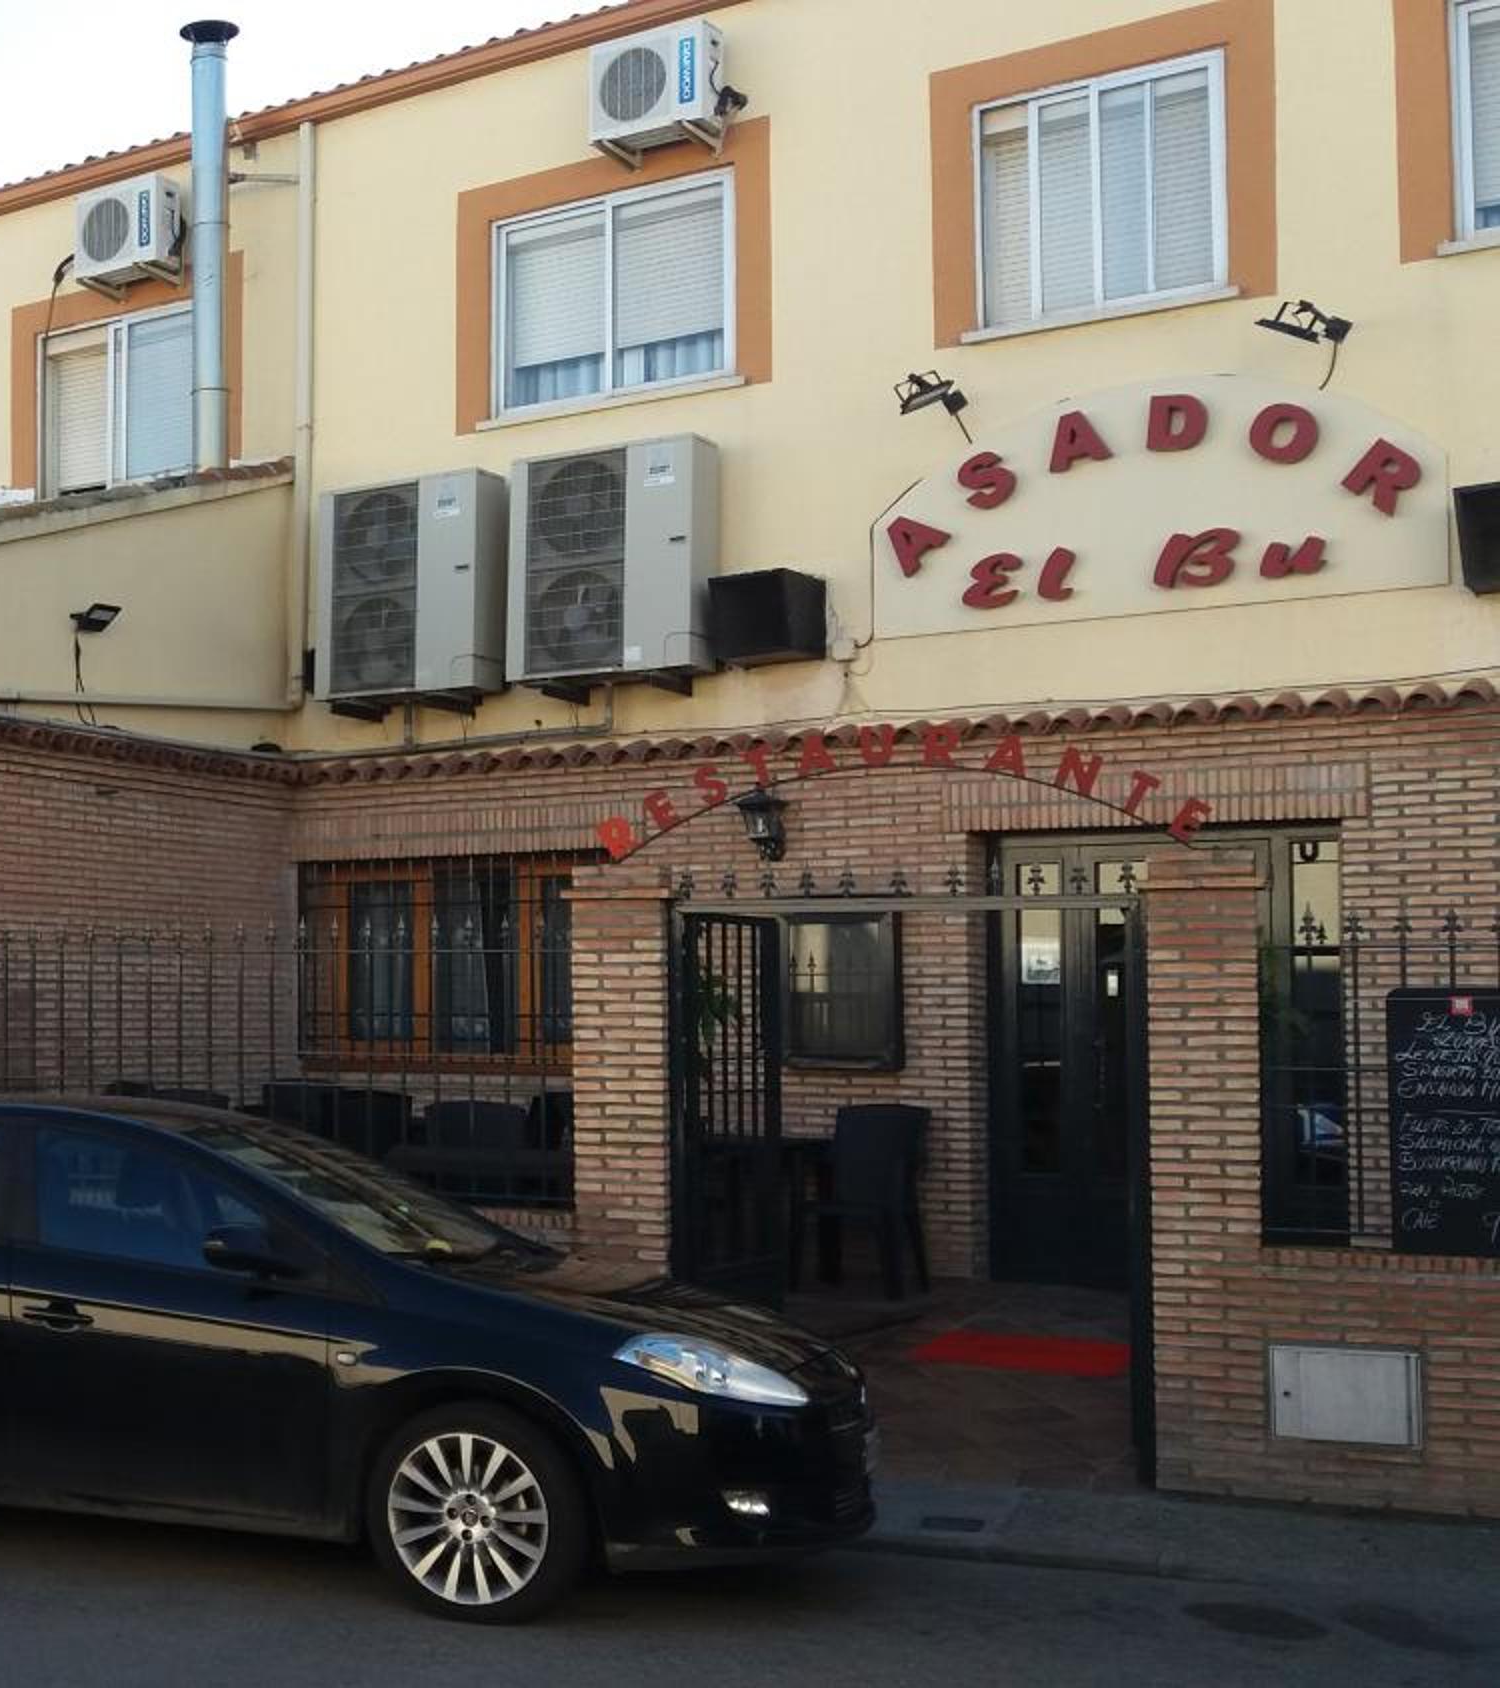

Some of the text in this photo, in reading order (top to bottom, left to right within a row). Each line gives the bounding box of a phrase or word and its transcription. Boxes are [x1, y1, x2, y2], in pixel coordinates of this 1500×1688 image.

[887, 394, 1423, 578] ASADOR
[1153, 527, 1328, 588] Bu
[596, 722, 1213, 861] RESTAURANTE
